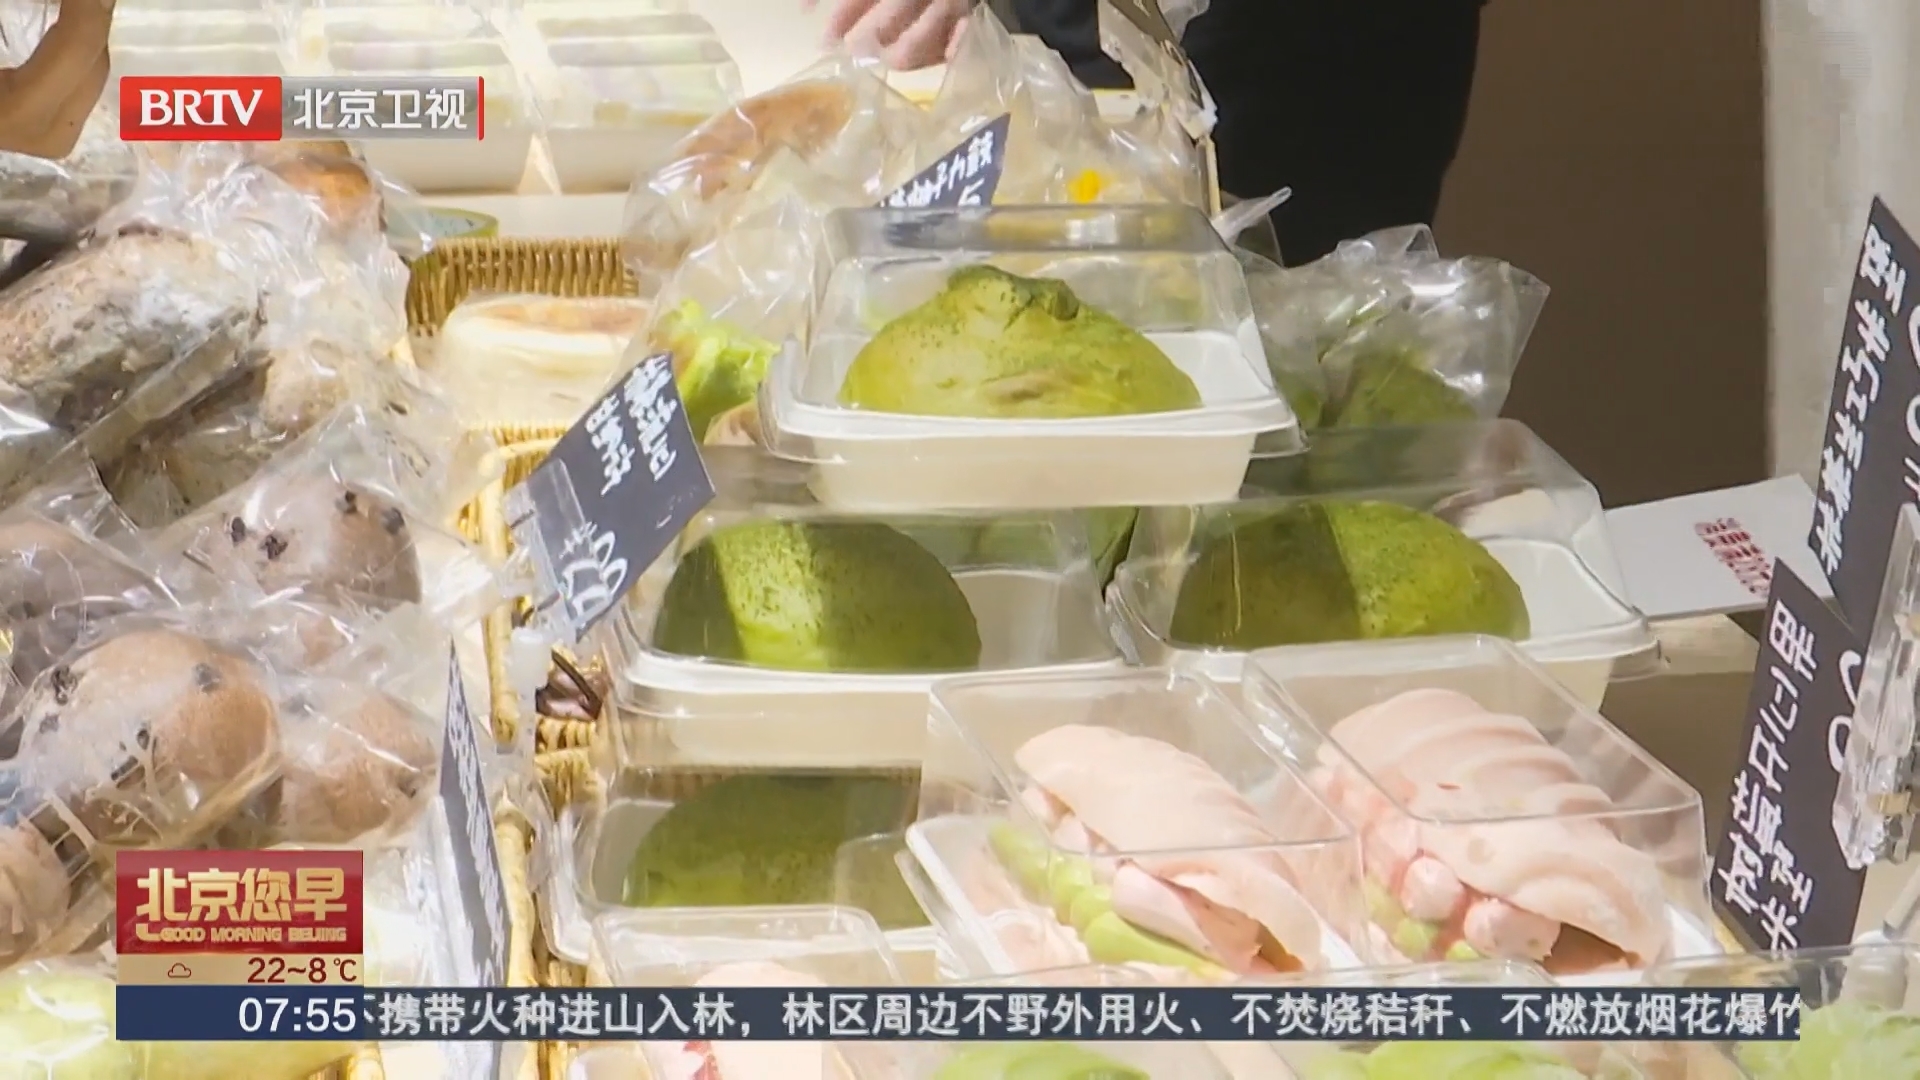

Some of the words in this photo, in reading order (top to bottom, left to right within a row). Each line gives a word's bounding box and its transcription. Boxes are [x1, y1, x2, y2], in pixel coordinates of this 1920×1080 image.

[1717, 599, 1818, 914] 树莓开心果
